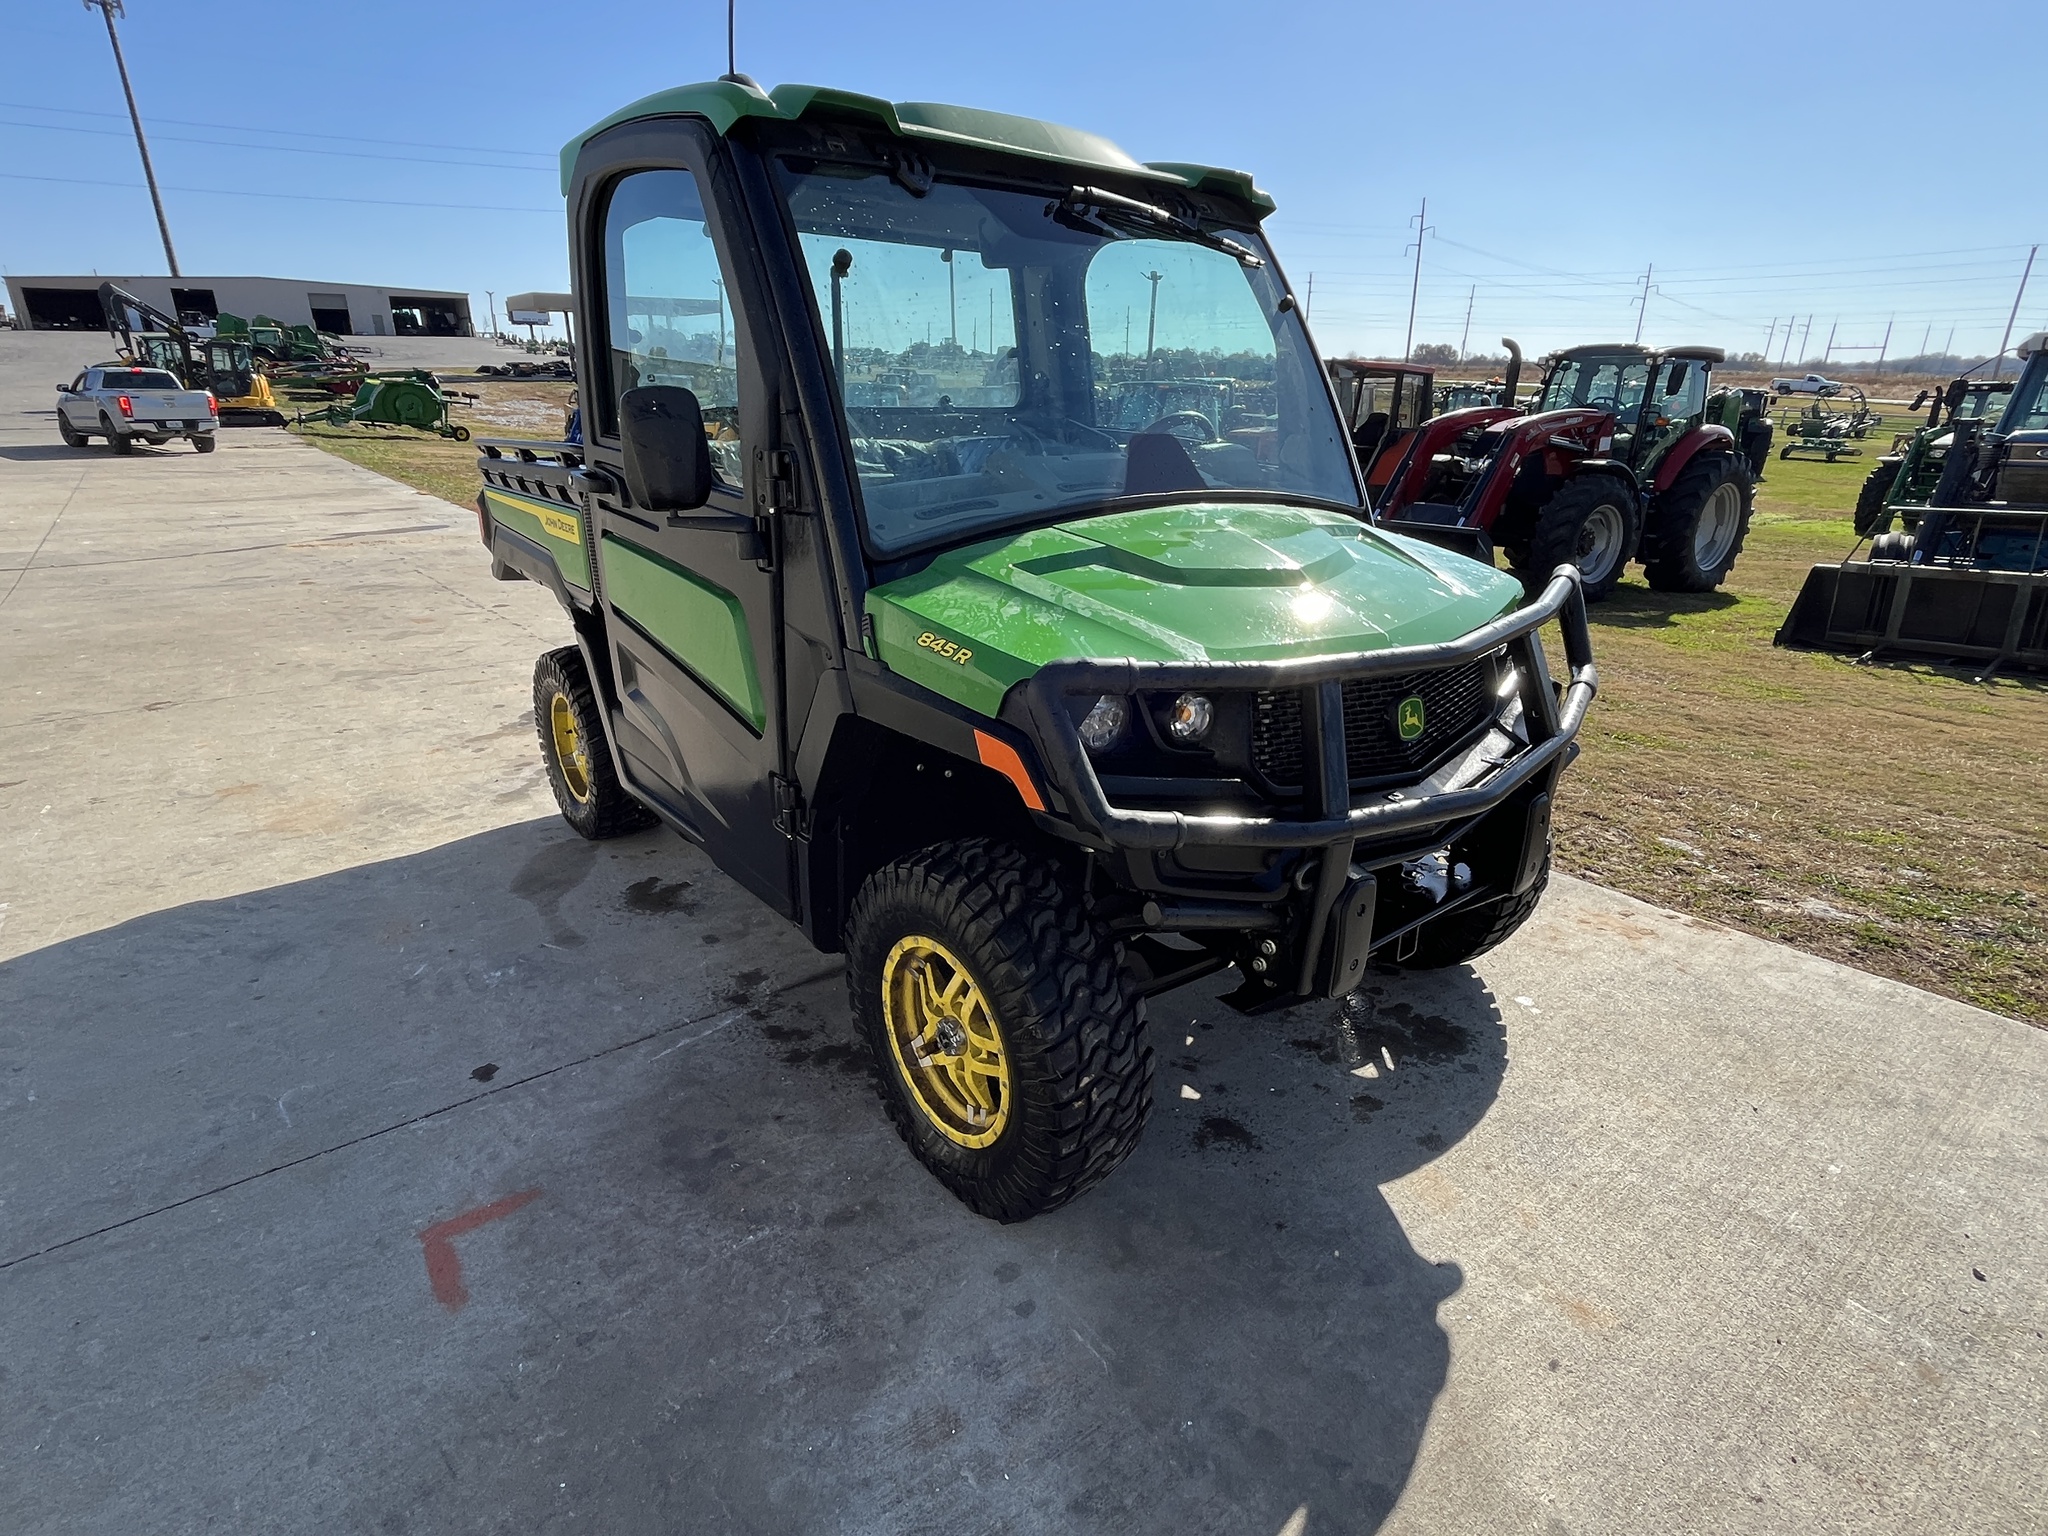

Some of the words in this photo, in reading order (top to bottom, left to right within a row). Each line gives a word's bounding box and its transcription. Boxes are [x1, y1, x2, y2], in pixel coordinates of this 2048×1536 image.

[545, 515, 557, 529] JOHN
[558, 518, 575, 535] DEERE
[917, 631, 974, 666] 845R
